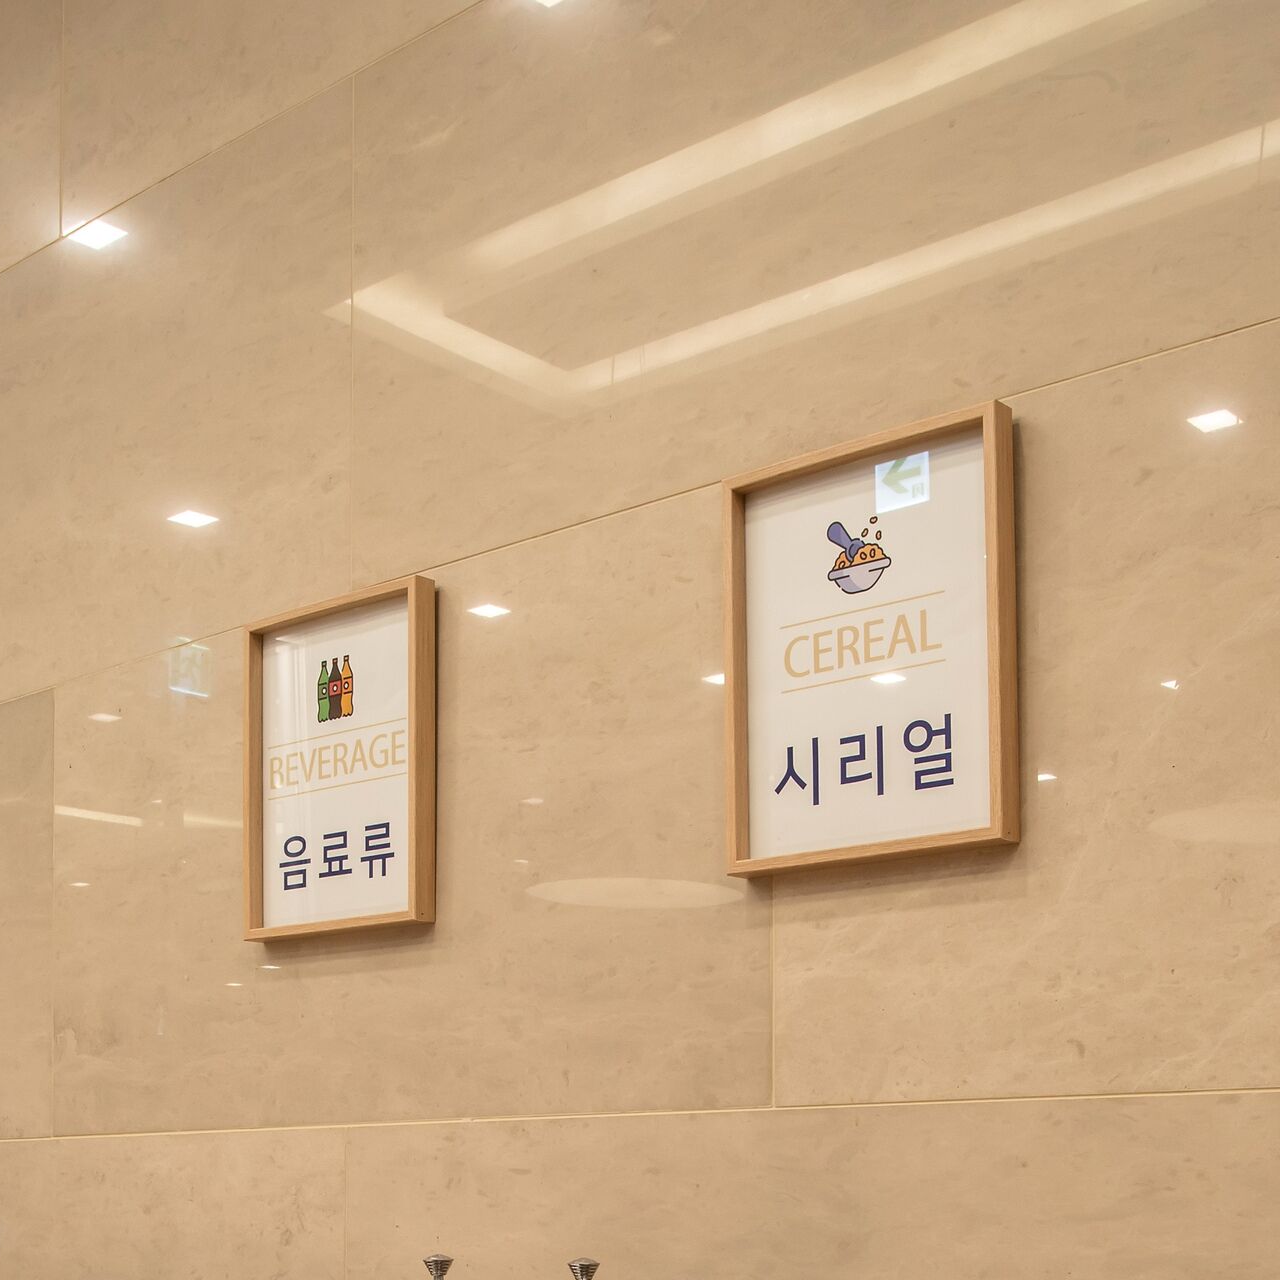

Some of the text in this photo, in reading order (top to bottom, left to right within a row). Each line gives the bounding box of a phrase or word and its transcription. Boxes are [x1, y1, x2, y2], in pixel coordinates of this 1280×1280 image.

[783, 609, 942, 679] CEREAL
[270, 730, 406, 789] BEVERAGE
[774, 713, 954, 806] 시리얼
[279, 821, 395, 891] 음료류
